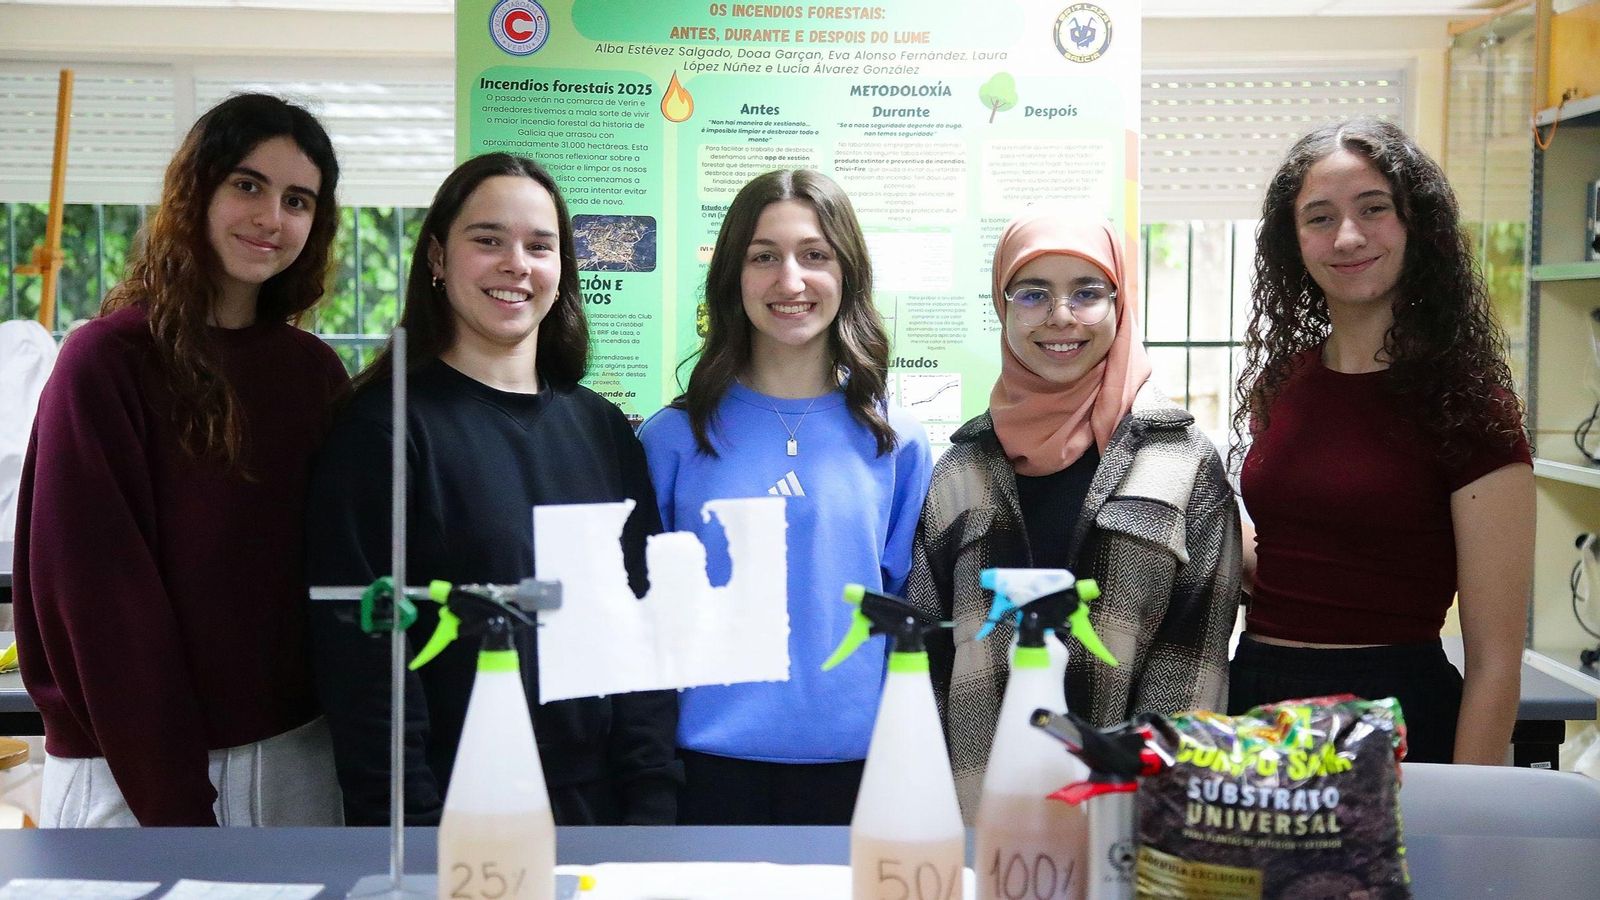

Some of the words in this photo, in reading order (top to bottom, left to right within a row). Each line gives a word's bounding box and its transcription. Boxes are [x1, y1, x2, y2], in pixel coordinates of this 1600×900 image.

[709, 4, 727, 18] OS
[732, 4, 803, 19] INCENDIOS
[808, 6, 885, 21] FORESTAIS:
[670, 27, 719, 41] ANTES,
[725, 28, 790, 42] DURANTE
[795, 29, 804, 42] E
[809, 29, 865, 43] DESPOIS
[871, 30, 888, 43] DO
[894, 30, 930, 44] LUME
[595, 43, 624, 54] Alba
[626, 44, 675, 55] Estévez
[678, 44, 730, 60] Salgado,
[738, 45, 771, 57] Doaa
[775, 46, 822, 61] Garçan,
[828, 47, 850, 58] Eva
[854, 47, 896, 58] Alonso
[972, 49, 1007, 60] Laura
[683, 60, 719, 75] López
[723, 60, 761, 72] Núñez
[777, 61, 810, 73] Lucía
[814, 58, 859, 74] Álvarez
[863, 63, 919, 75] González
[480, 78, 549, 92] Incendios
[552, 80, 614, 94] forestais
[617, 83, 652, 96] 2025
[850, 81, 952, 97] METODOLOXÍA
[494, 94, 527, 104] pasado
[482, 105, 532, 113] arrededores
[534, 107, 567, 115] tivemos
[740, 104, 780, 115] Antes
[872, 106, 930, 118] Durante
[1024, 105, 1078, 119] Despois
[520, 118, 556, 126] incendio
[483, 139, 559, 150] aproximadamente
[566, 152, 608, 160] reflexionar
[584, 164, 610, 174] limpar
[579, 274, 611, 290] CIÓN
[615, 280, 623, 290] E
[584, 293, 611, 304] VOS
[889, 357, 938, 368] ultados
[1188, 776, 1340, 811] SUBSTRATO
[1186, 803, 1341, 836] UNIVERSAL
